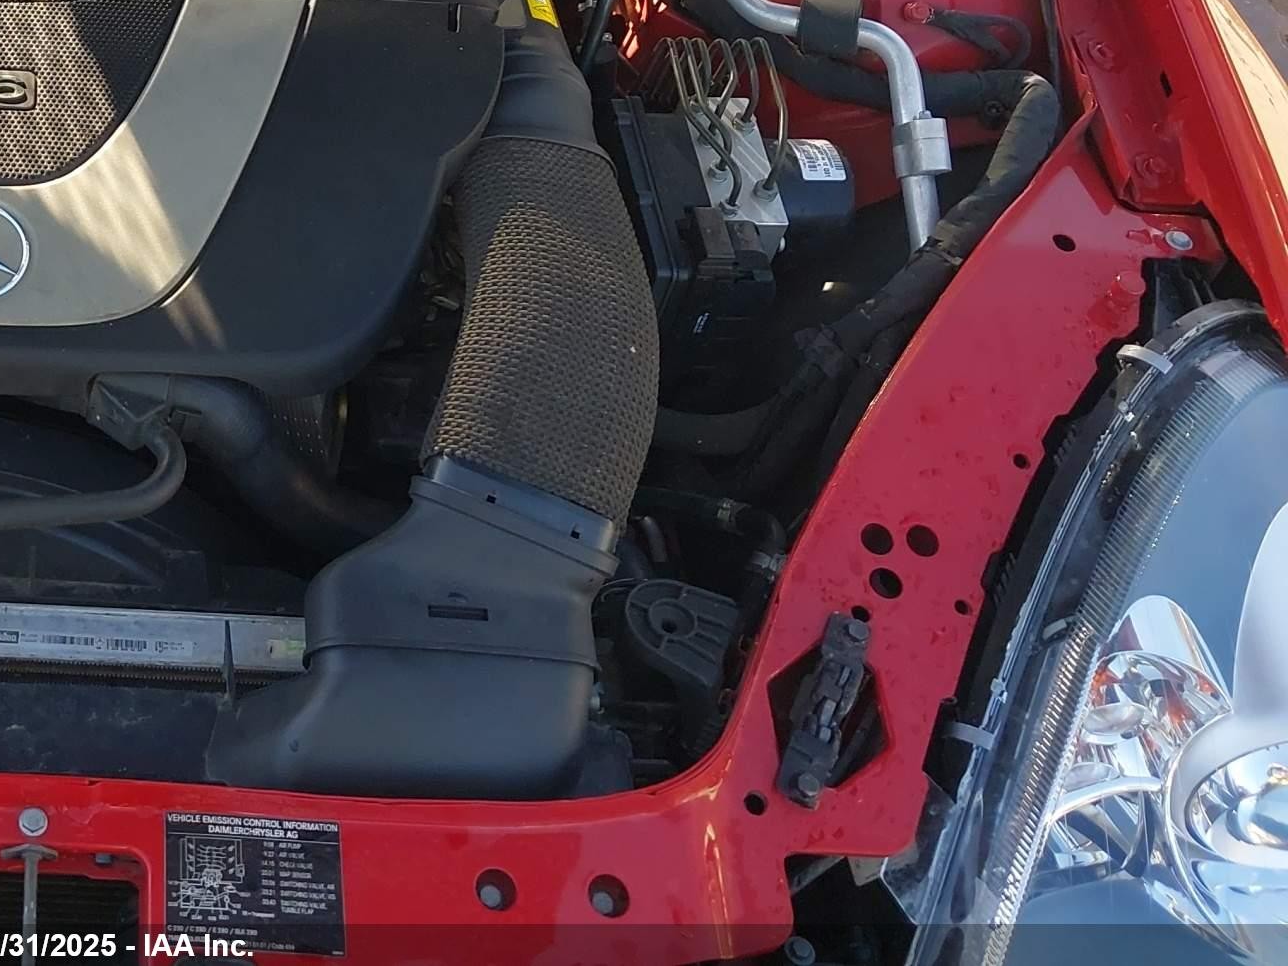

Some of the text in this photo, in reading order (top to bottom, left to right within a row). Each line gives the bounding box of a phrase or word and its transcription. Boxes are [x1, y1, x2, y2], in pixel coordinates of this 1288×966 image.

[168, 813, 338, 832] VEHICLE EMISSION CONTROL INFORMATION
[208, 824, 298, 839] DAIMLERCHRYSLER AG
